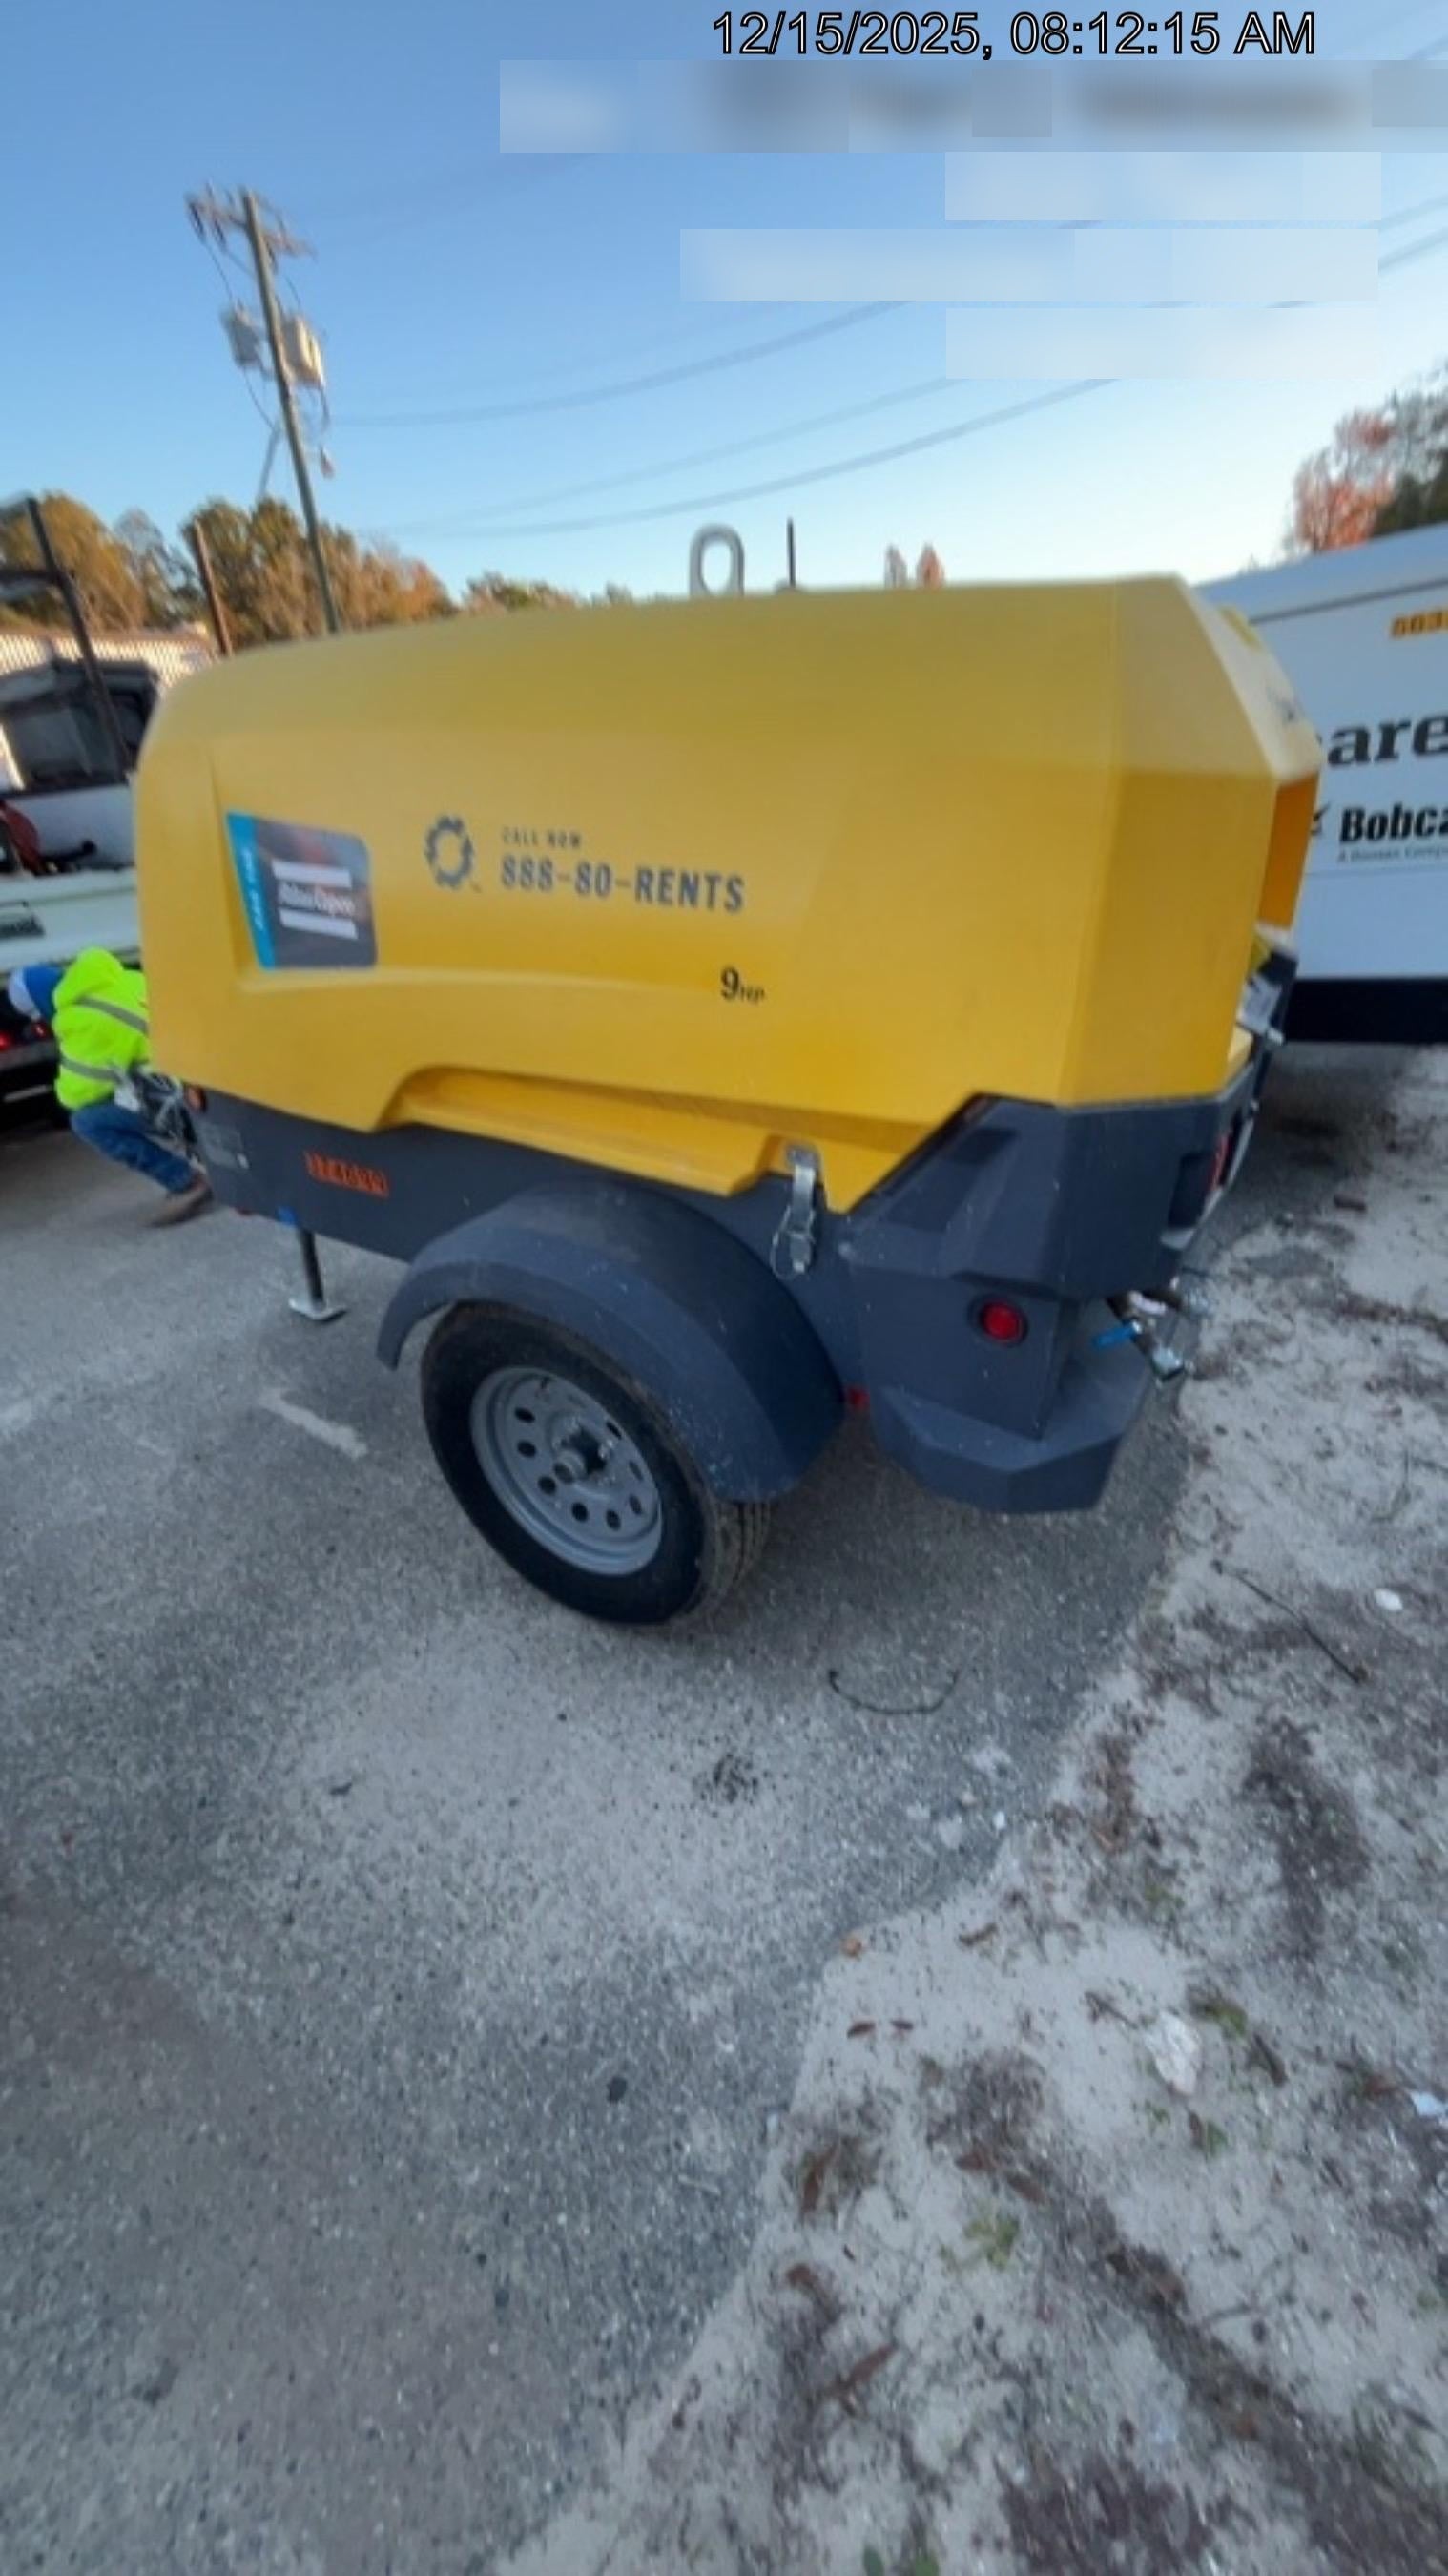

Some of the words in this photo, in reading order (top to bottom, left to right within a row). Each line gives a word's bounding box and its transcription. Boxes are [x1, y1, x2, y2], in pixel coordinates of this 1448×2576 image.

[1316, 714, 1448, 767] are
[502, 826, 539, 847] CALL
[547, 831, 582, 849] NOW
[501, 855, 745, 914] 888-80-RENTS
